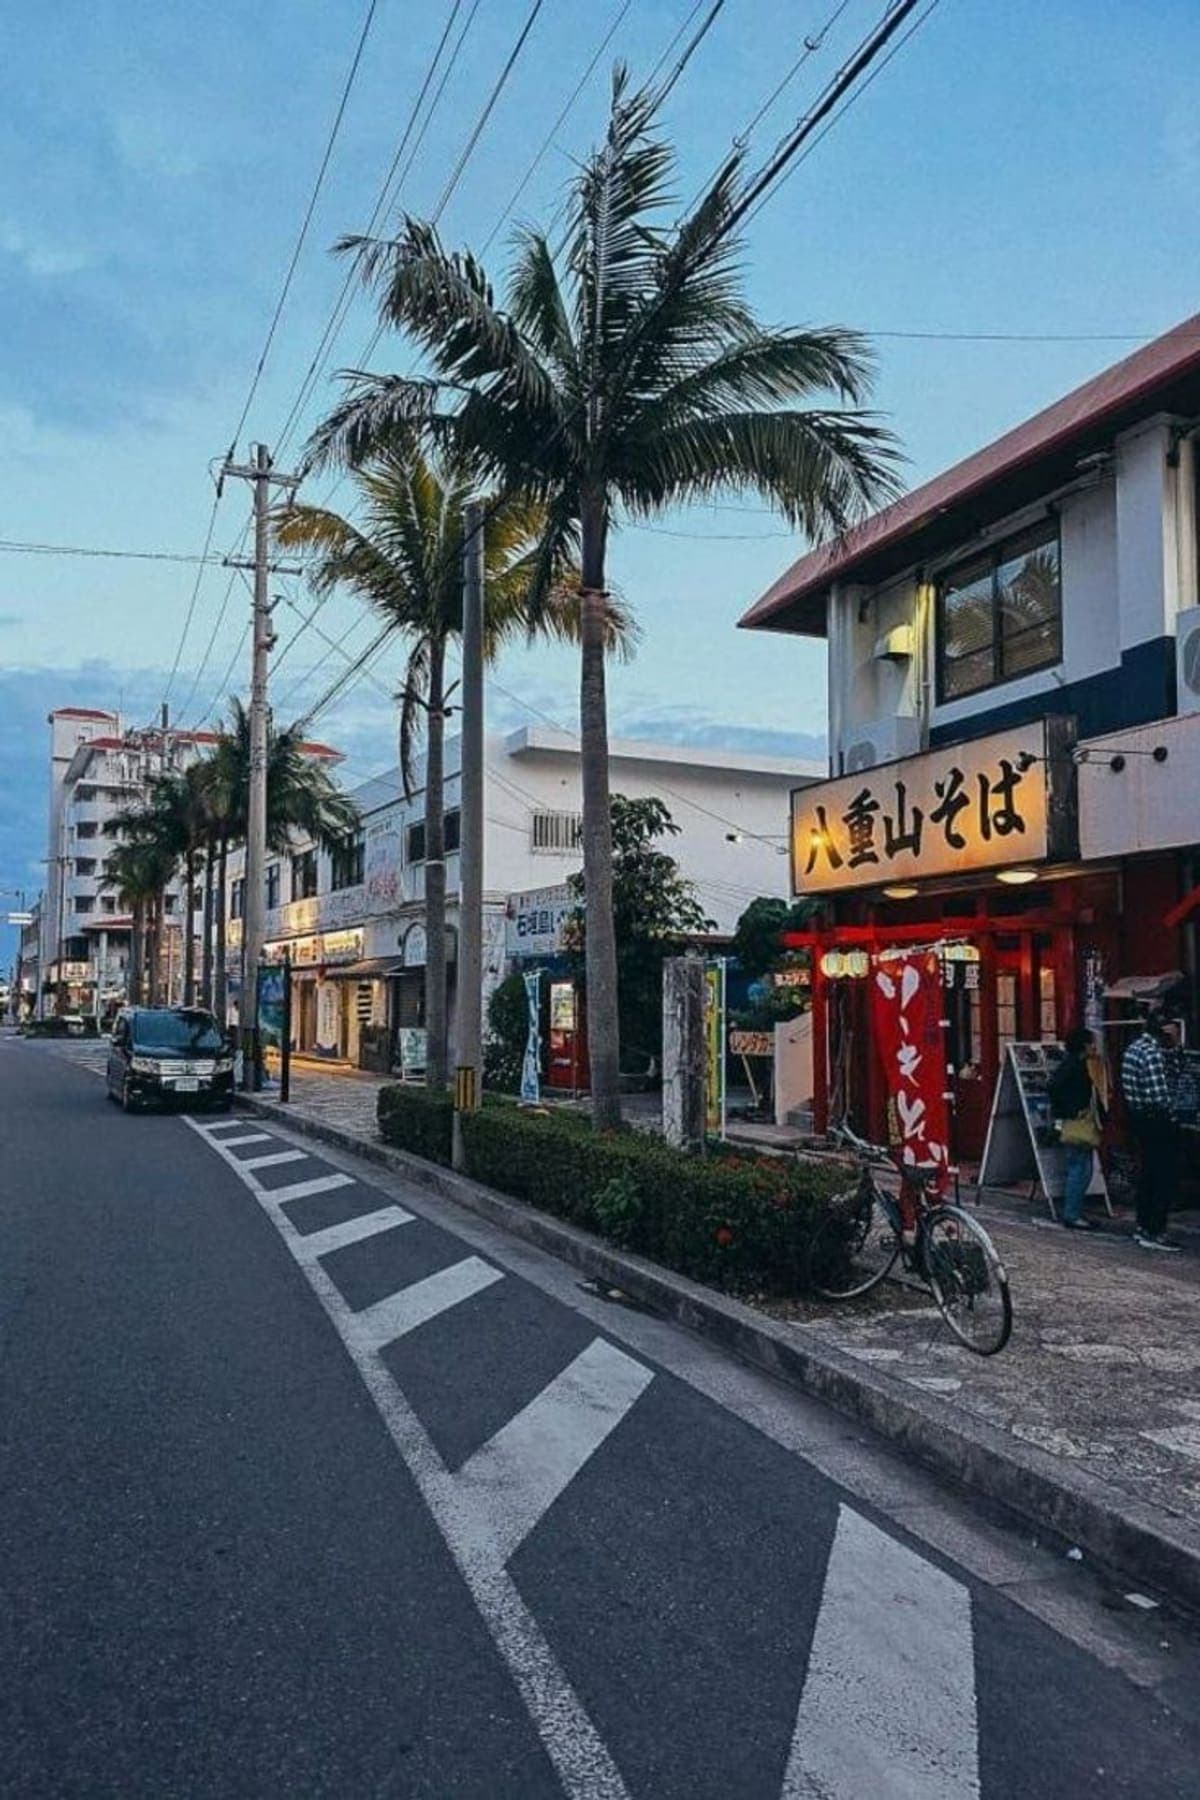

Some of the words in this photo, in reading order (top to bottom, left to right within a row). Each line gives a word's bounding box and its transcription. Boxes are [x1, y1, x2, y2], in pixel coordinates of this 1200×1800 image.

[804, 752, 1036, 875] 八重山そば
